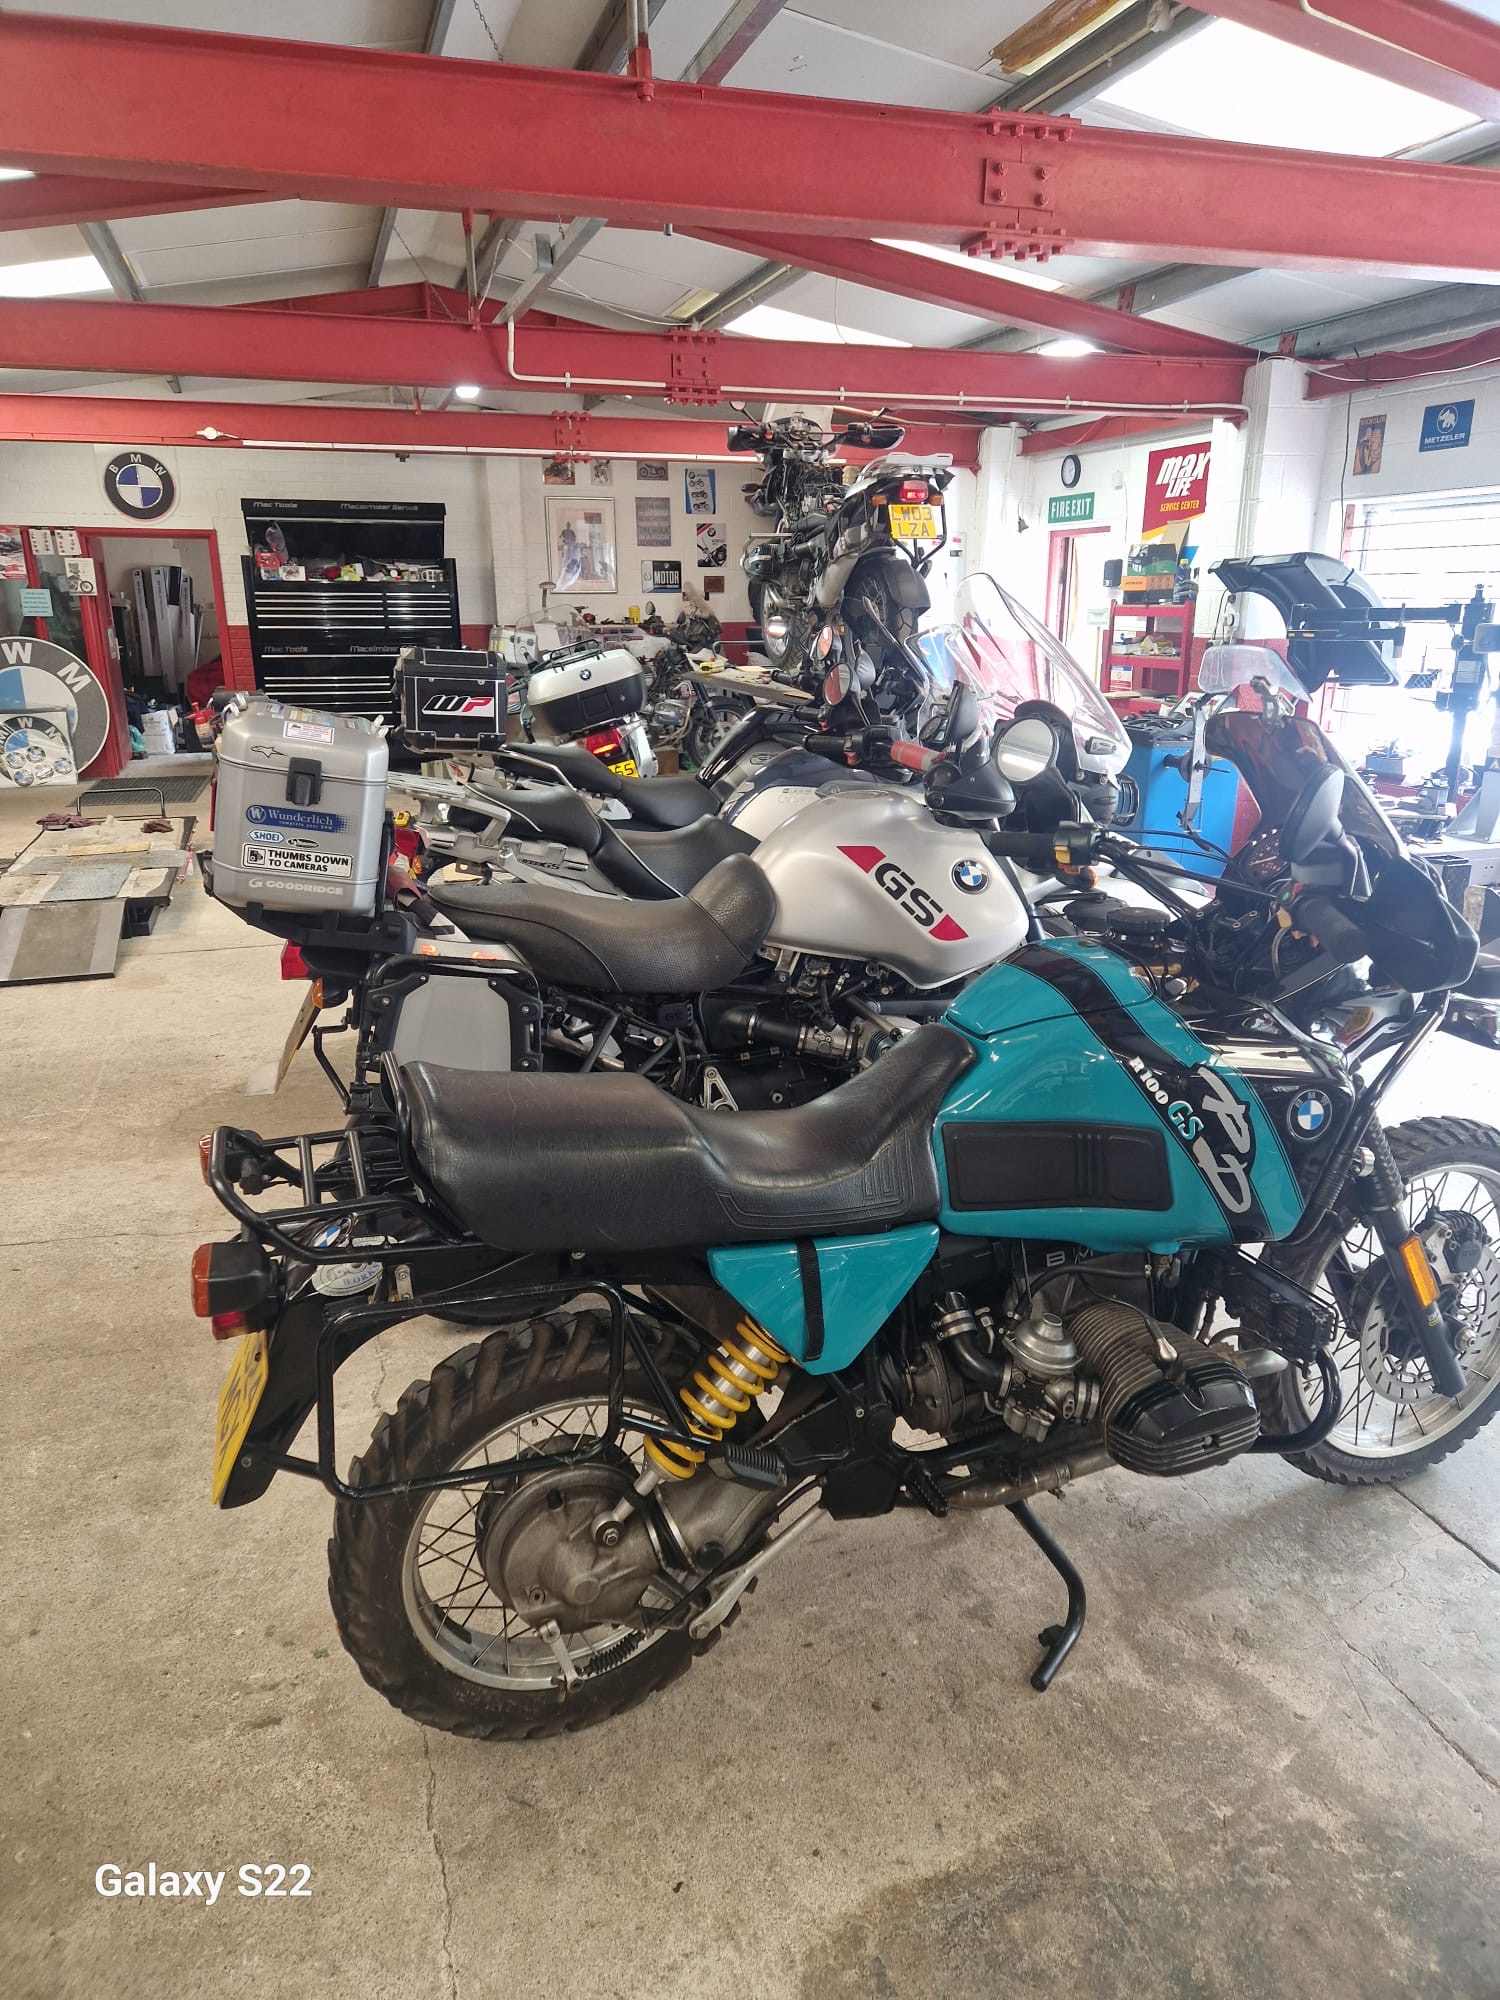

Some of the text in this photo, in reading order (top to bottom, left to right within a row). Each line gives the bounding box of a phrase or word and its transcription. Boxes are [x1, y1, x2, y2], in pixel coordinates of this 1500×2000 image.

[1424, 433, 1466, 444] METZELER
[1165, 477, 1191, 499] LIFE
[891, 506, 933, 520] LW03
[1051, 498, 1091, 518] FIRE EXIT
[1160, 500, 1200, 512] SERVICE CENTER
[898, 523, 930, 536] LZA
[654, 570, 680, 585] MOTOR
[268, 809, 333, 826] Wunderlich
[254, 831, 280, 841] SHOEI
[268, 849, 349, 866] THUMBS DOWN
[269, 858, 328, 872] TO CAMERAS
[266, 880, 344, 896] GOODRIDGE
[875, 863, 944, 927] GS
[1129, 1056, 1145, 1074] R
[1140, 1070, 1169, 1105] 100
[1168, 1100, 1205, 1141] GS
